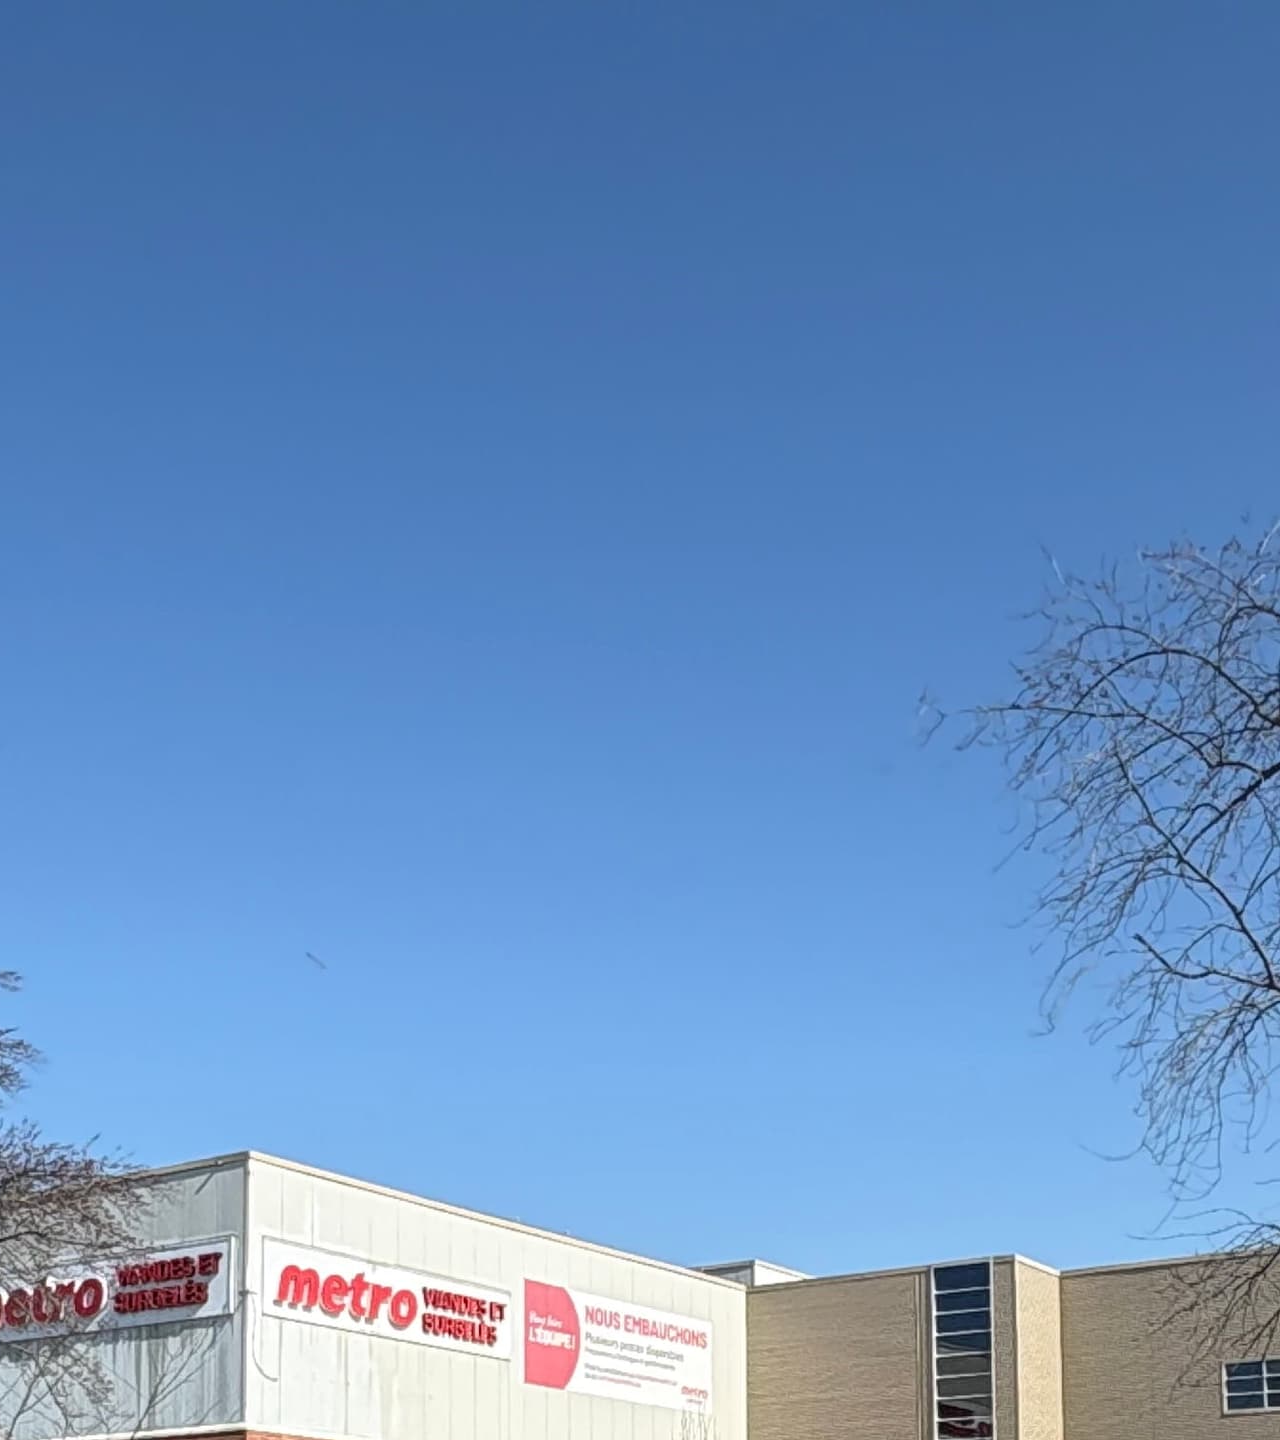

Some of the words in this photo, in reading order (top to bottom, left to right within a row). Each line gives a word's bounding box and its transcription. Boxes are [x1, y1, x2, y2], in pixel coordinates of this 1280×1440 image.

[198, 1252, 223, 1275] ET
[276, 1264, 418, 1328] metro
[422, 1286, 487, 1319] VIANDES
[490, 1301, 508, 1322] ET
[585, 1305, 621, 1331] NOUS
[624, 1314, 708, 1350] EMBAUCHONS
